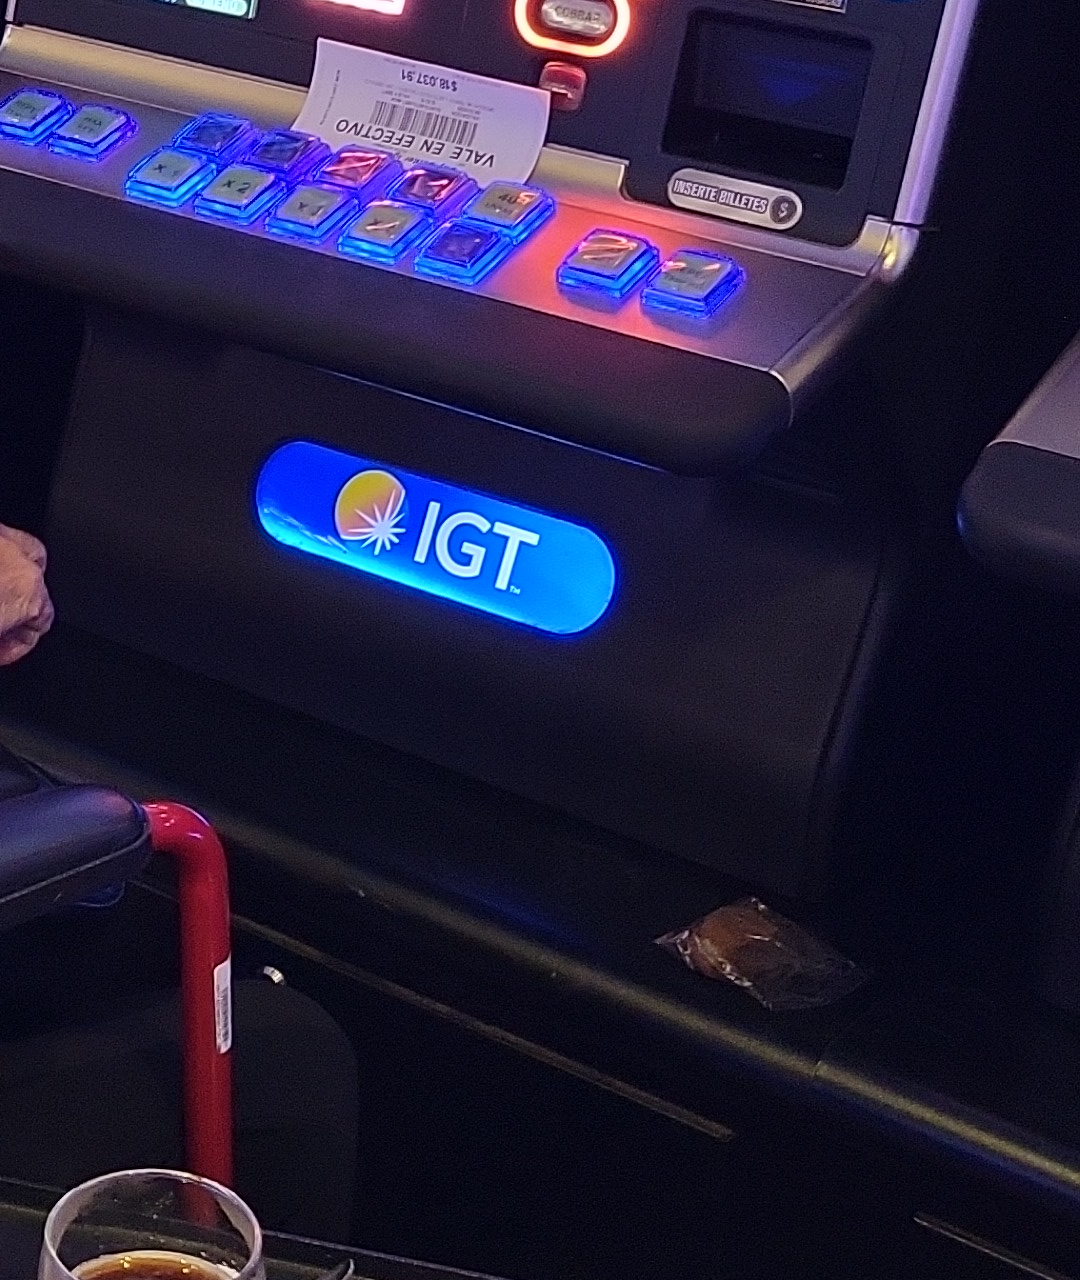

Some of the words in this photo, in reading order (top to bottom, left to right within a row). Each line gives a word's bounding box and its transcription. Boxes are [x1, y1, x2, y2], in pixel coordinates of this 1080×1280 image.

[336, 118, 417, 149] EFECTIVO
[420, 137, 446, 156] EN
[448, 145, 496, 168] VALE
[672, 179, 718, 201] INSERTE
[718, 188, 768, 214] BILLETES
[413, 501, 541, 591] IGT
